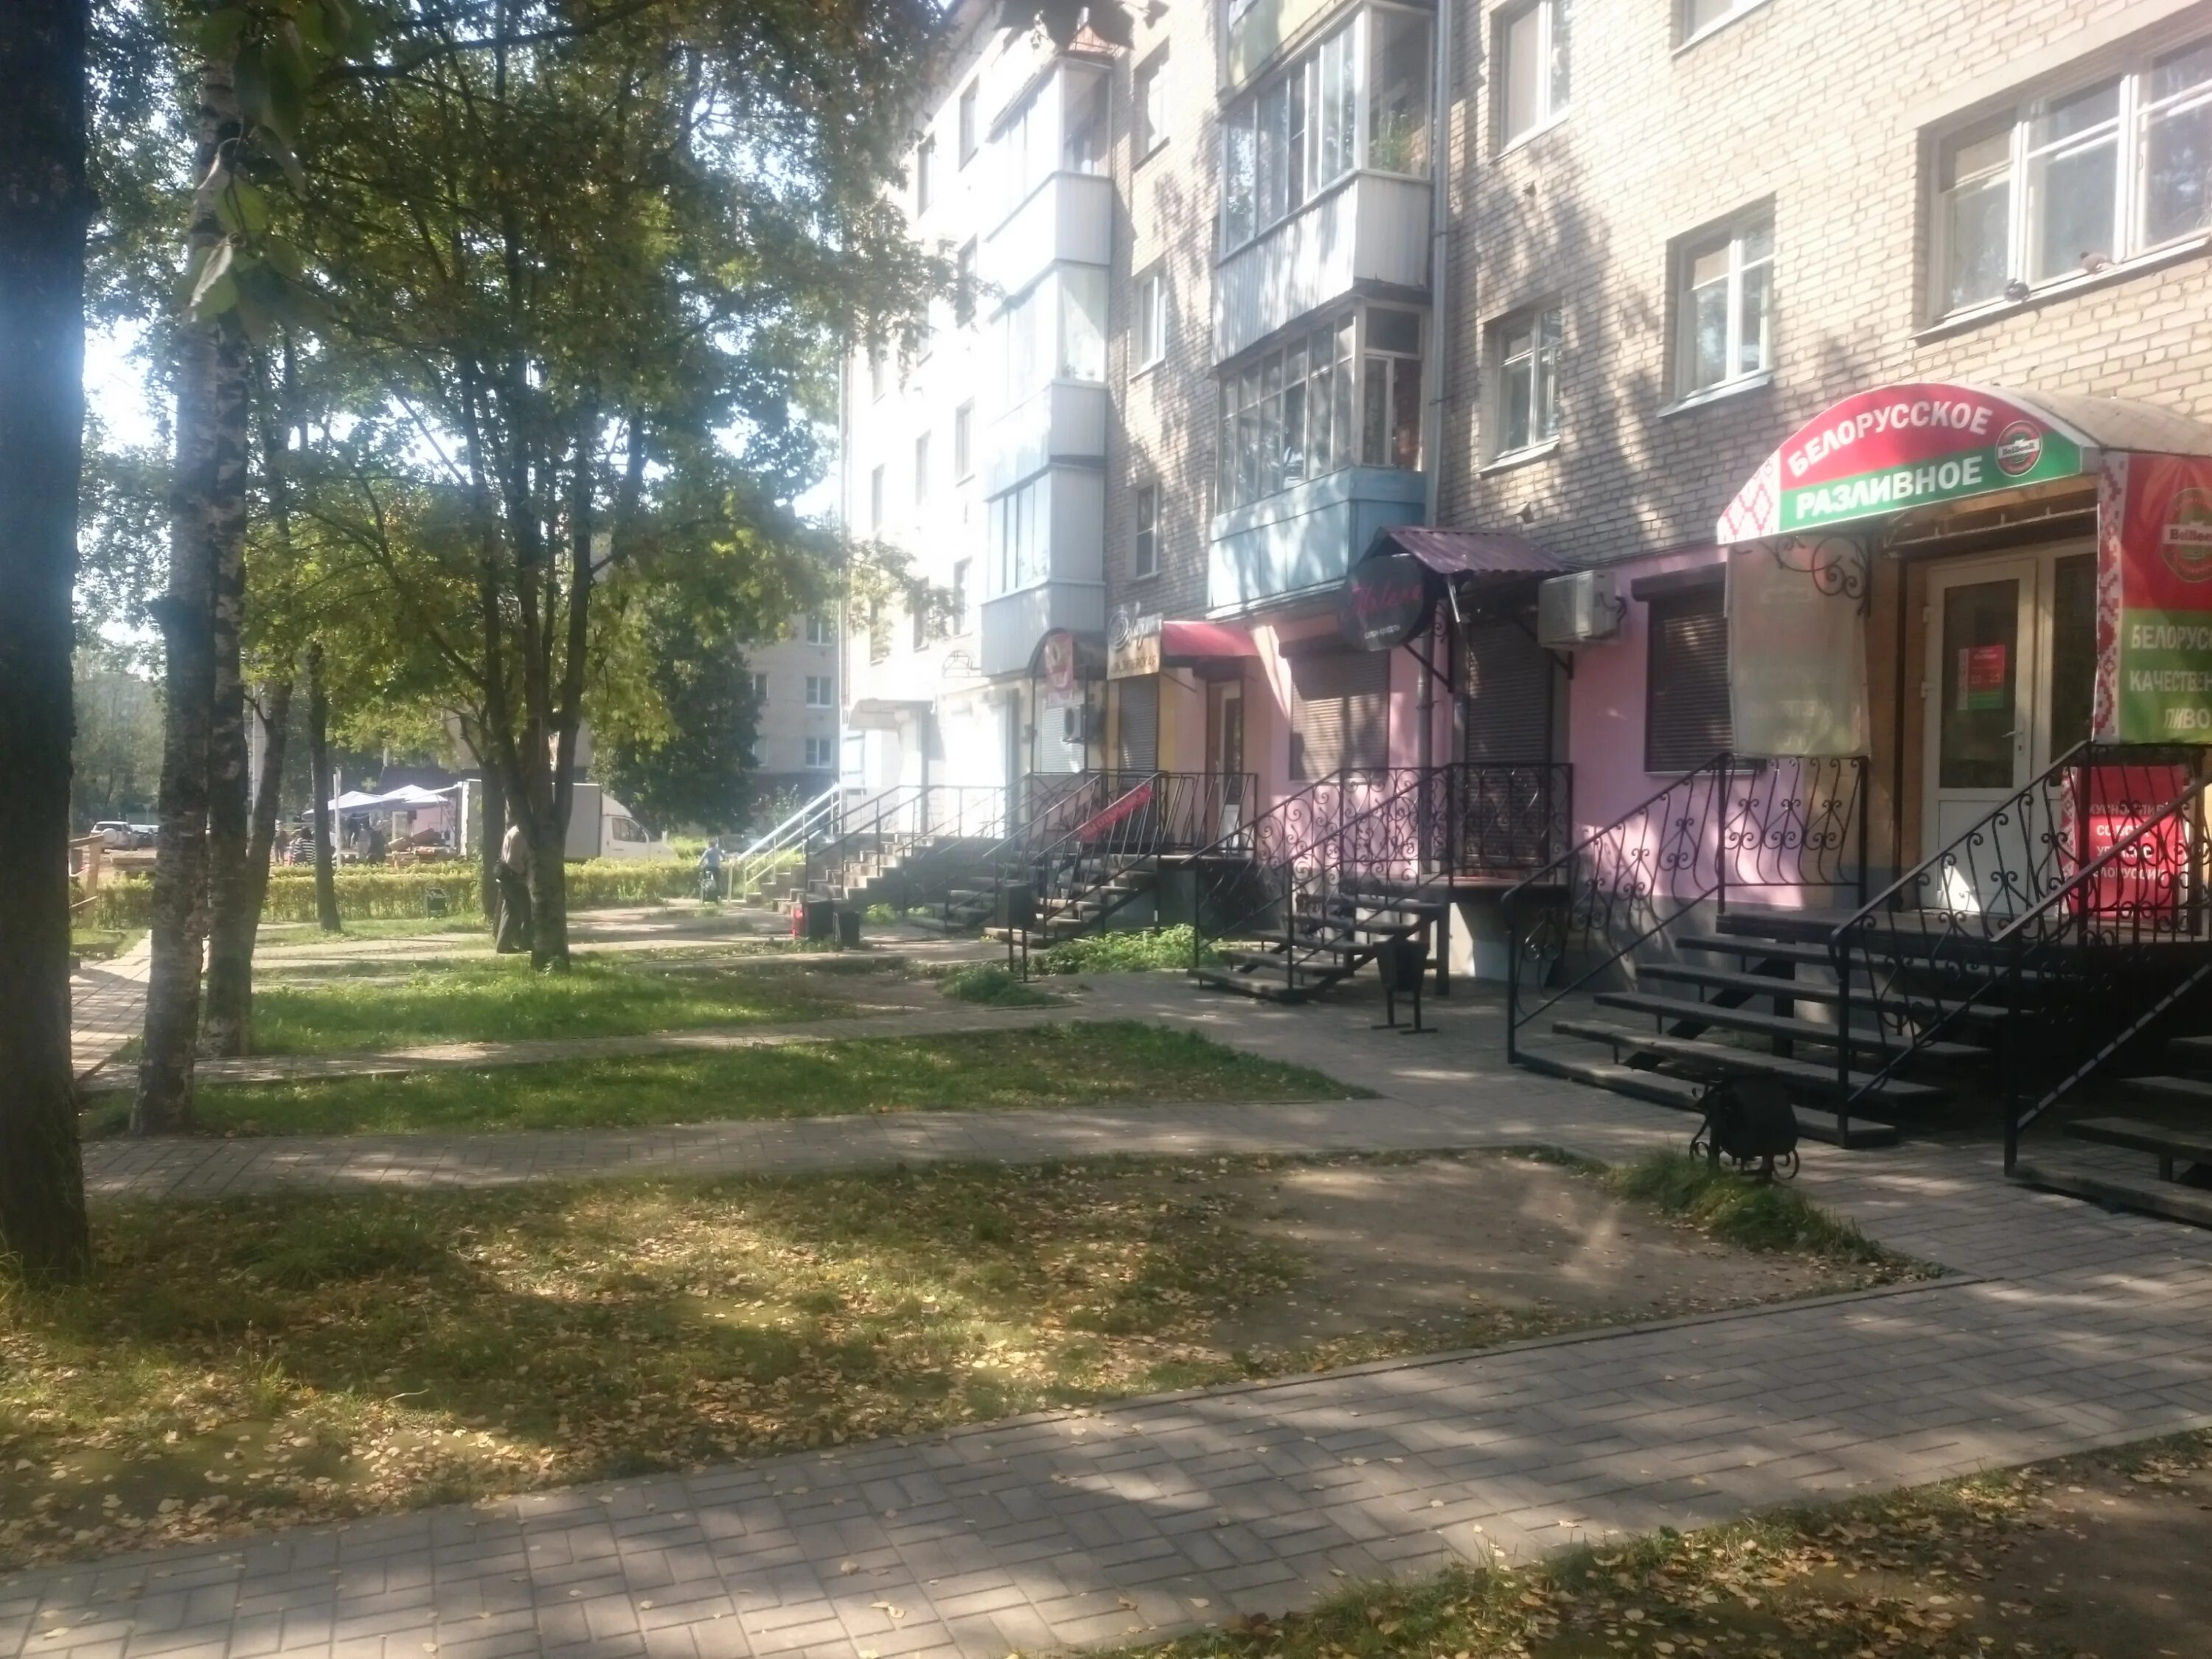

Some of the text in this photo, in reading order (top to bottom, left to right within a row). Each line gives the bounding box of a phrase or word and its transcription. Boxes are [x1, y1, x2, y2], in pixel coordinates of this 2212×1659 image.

[1787, 401, 1993, 478] БЕЛОРУССКОЕ
[1796, 456, 1983, 520] РАЗЛИВНОЕ
[2164, 708, 2211, 728] ПИВО
